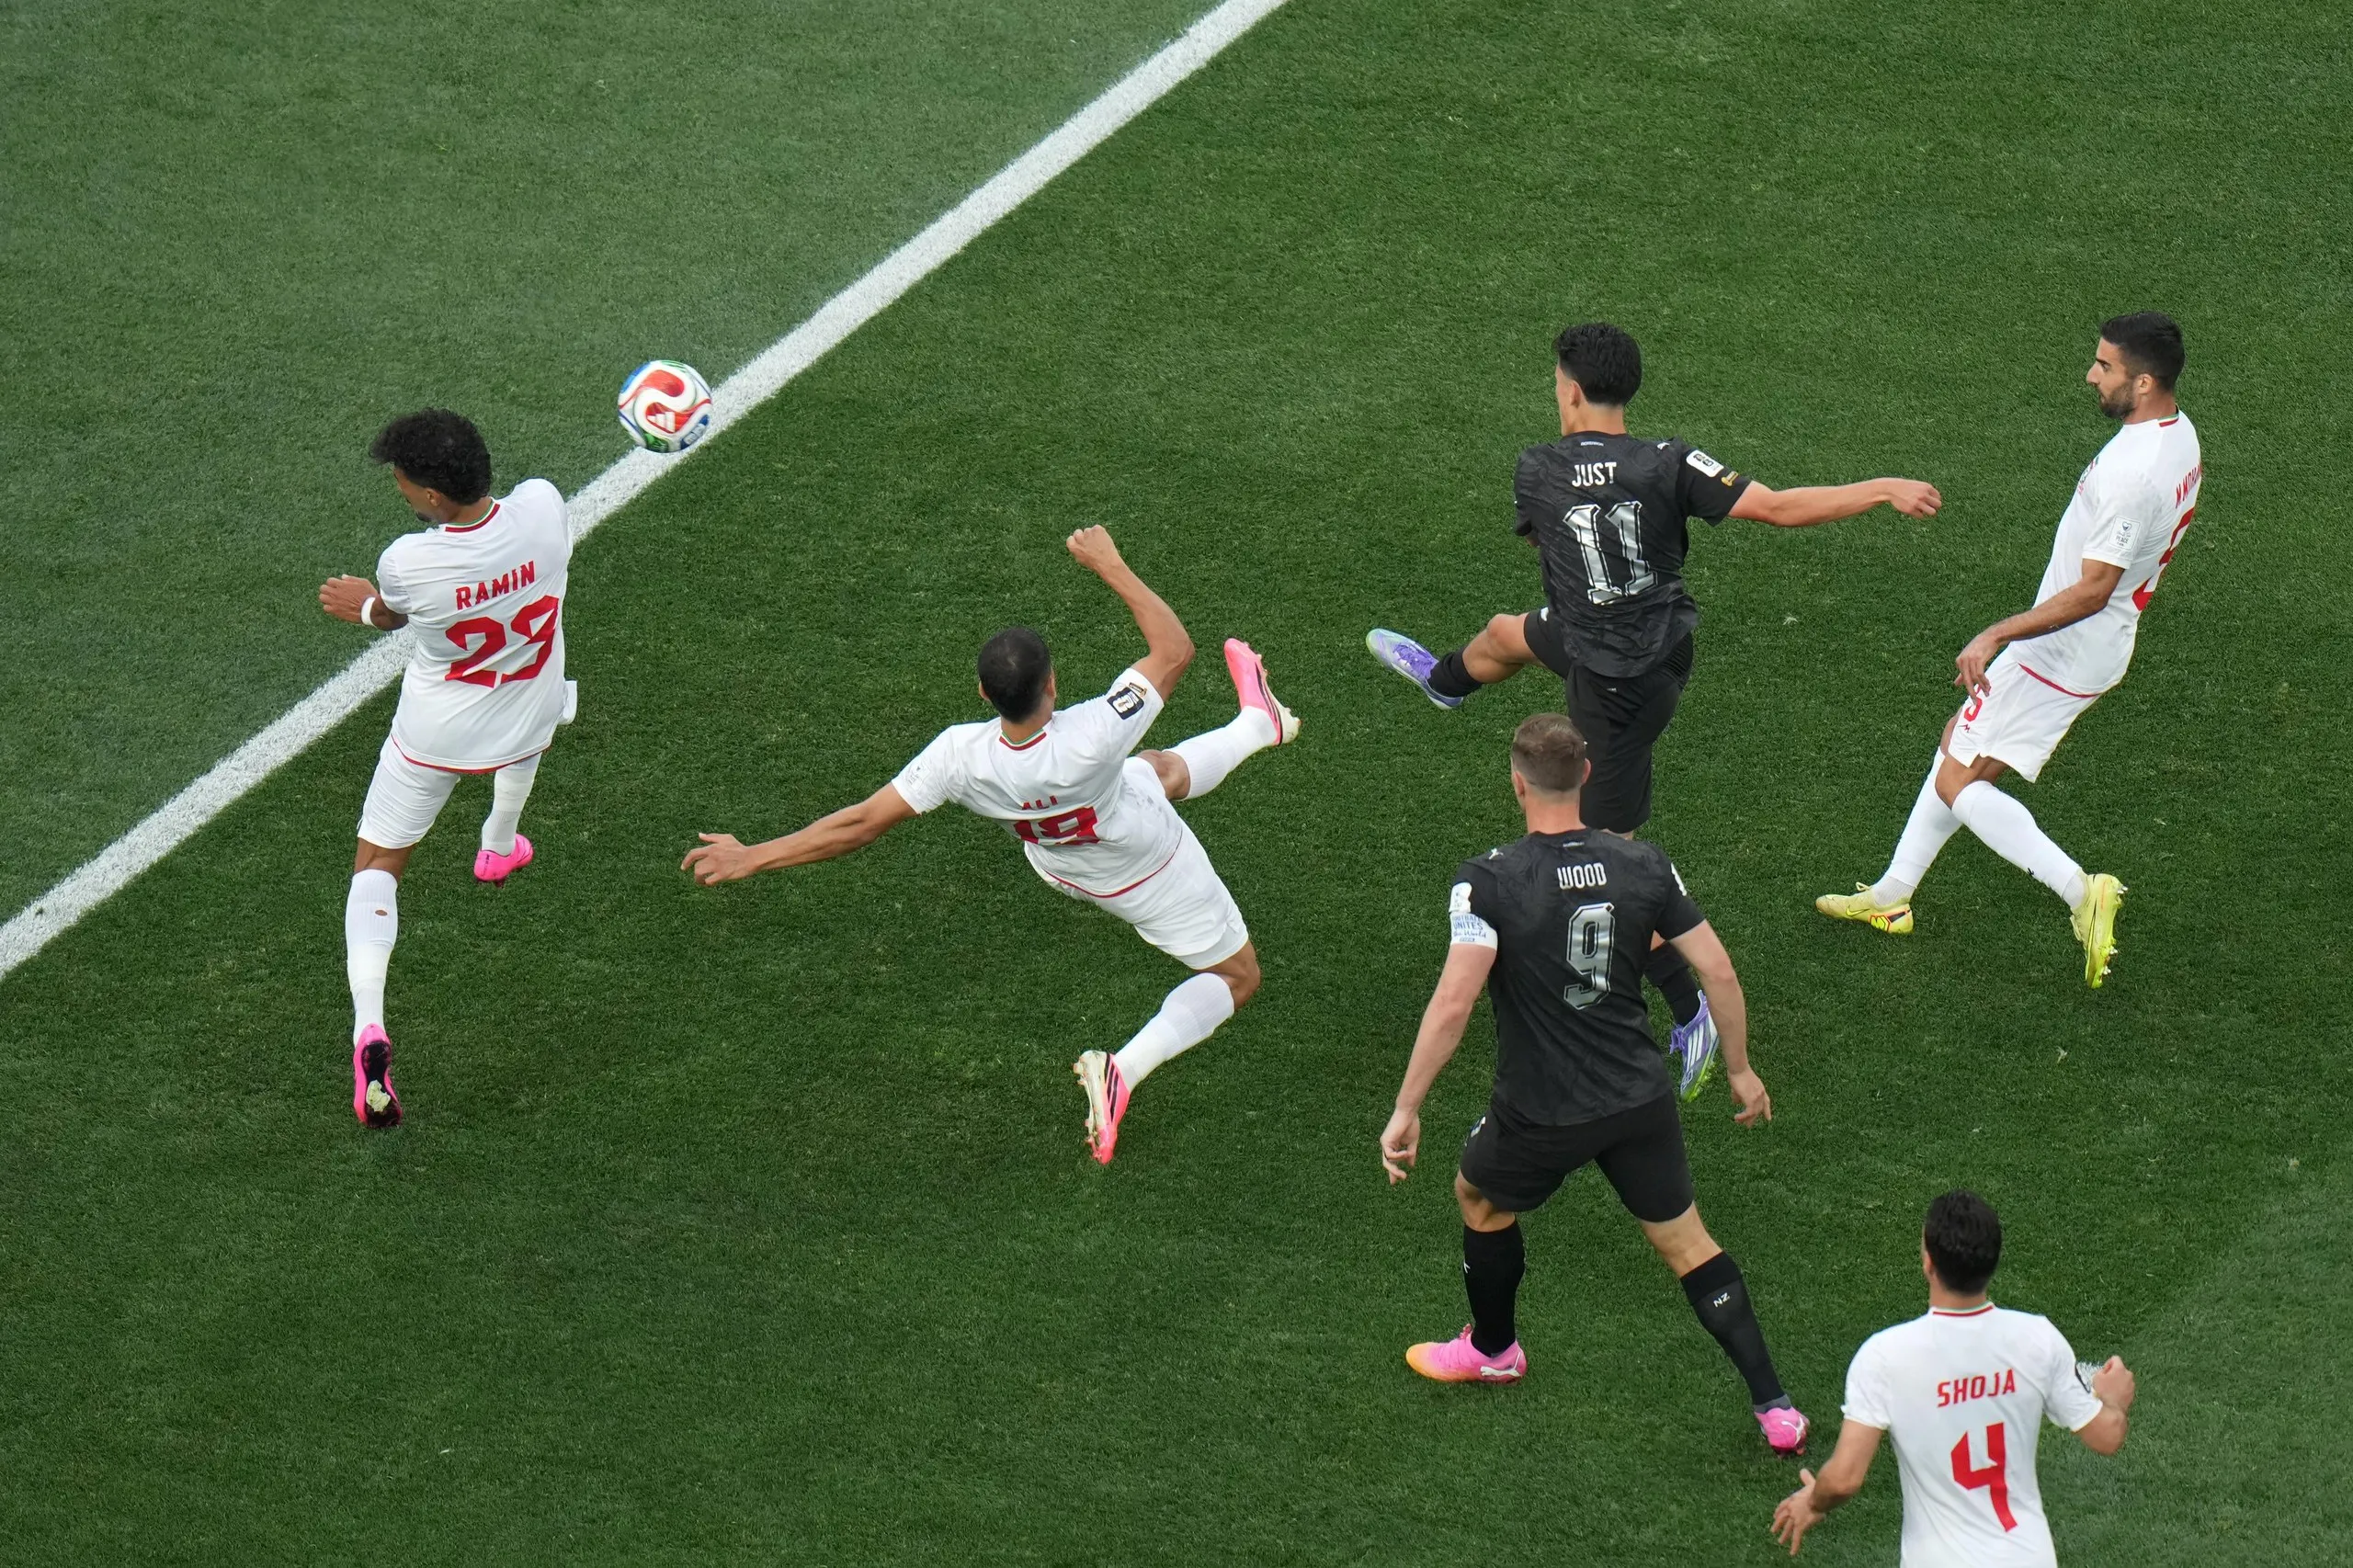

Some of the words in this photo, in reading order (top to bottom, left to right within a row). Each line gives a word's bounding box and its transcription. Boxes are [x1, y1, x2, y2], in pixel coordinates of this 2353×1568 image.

[1571, 461, 1618, 488] JUST
[1562, 499, 1658, 607] 11
[455, 560, 536, 611] RAMIN
[444, 595, 560, 689] 29
[1022, 795, 1058, 811] ALI
[1556, 862, 1608, 891] WOOD
[1454, 922, 1483, 930] UNITES
[1563, 901, 1616, 1011] 9
[1712, 1291, 1732, 1308] NZ
[1936, 1368, 2017, 1408] SHOJA
[1950, 1421, 2018, 1533] 4
